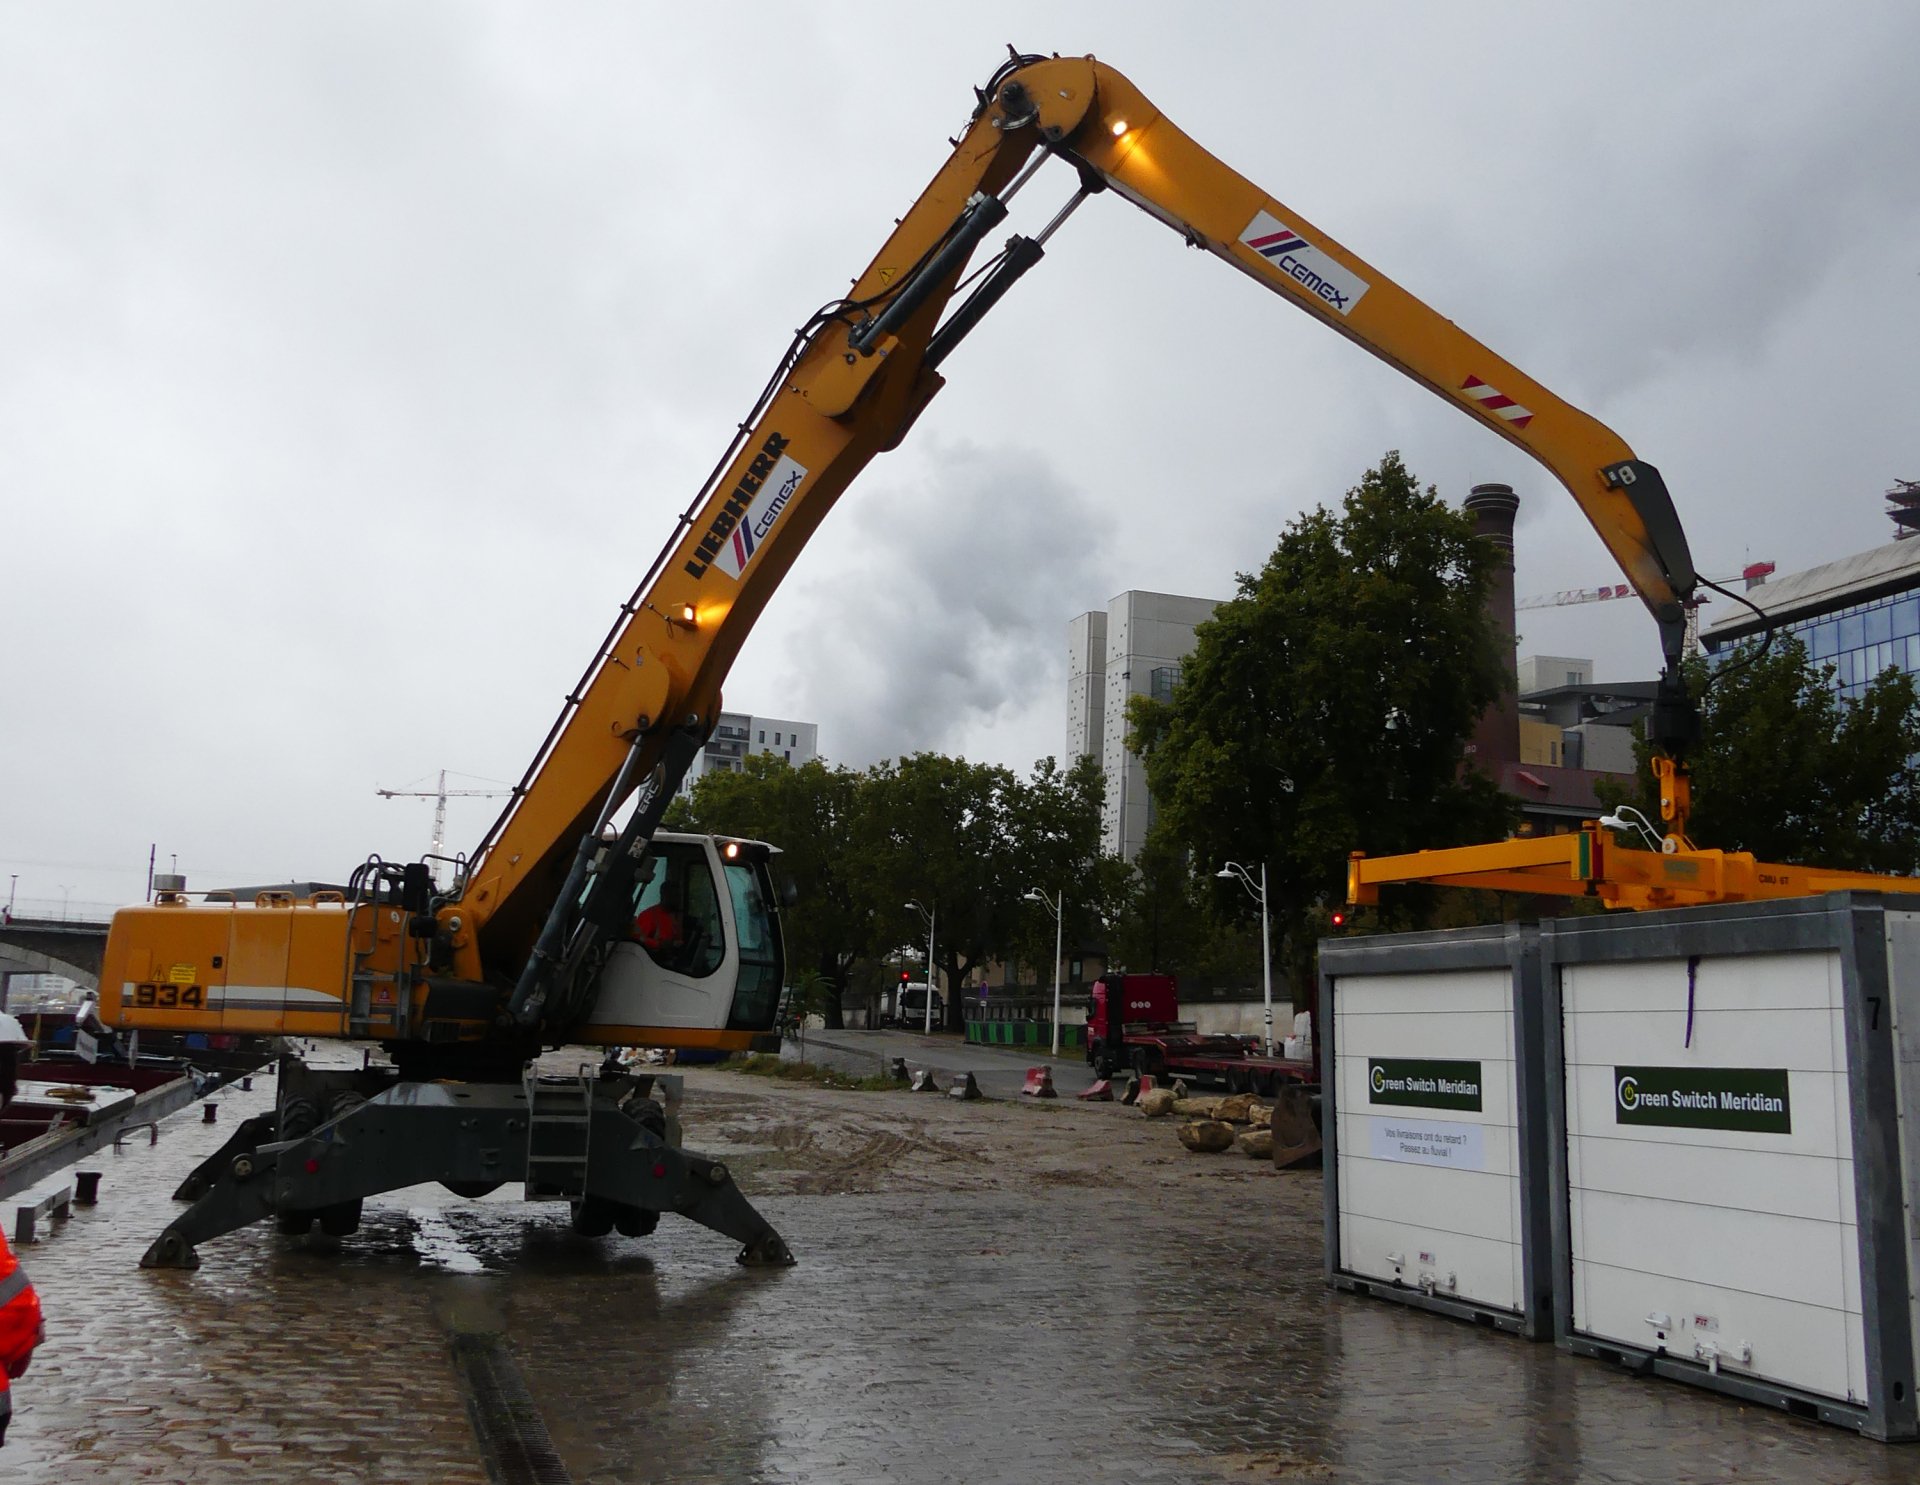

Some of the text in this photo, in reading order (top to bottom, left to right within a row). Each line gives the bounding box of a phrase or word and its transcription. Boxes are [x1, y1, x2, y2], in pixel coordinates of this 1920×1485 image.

[1279, 255, 1349, 309] CEMEX
[684, 432, 791, 580] LIEBHERR
[754, 470, 802, 539] CEMEX
[137, 984, 203, 1008] 934
[1866, 997, 1881, 1030] 7
[1371, 1066, 1479, 1095] Green Switch Meridian
[1618, 1076, 1783, 1112] Green Switch Meridian
[1384, 1128, 1395, 1138] Vos
[1443, 1134, 1461, 1145] retard
[1399, 1142, 1421, 1154] Passez
